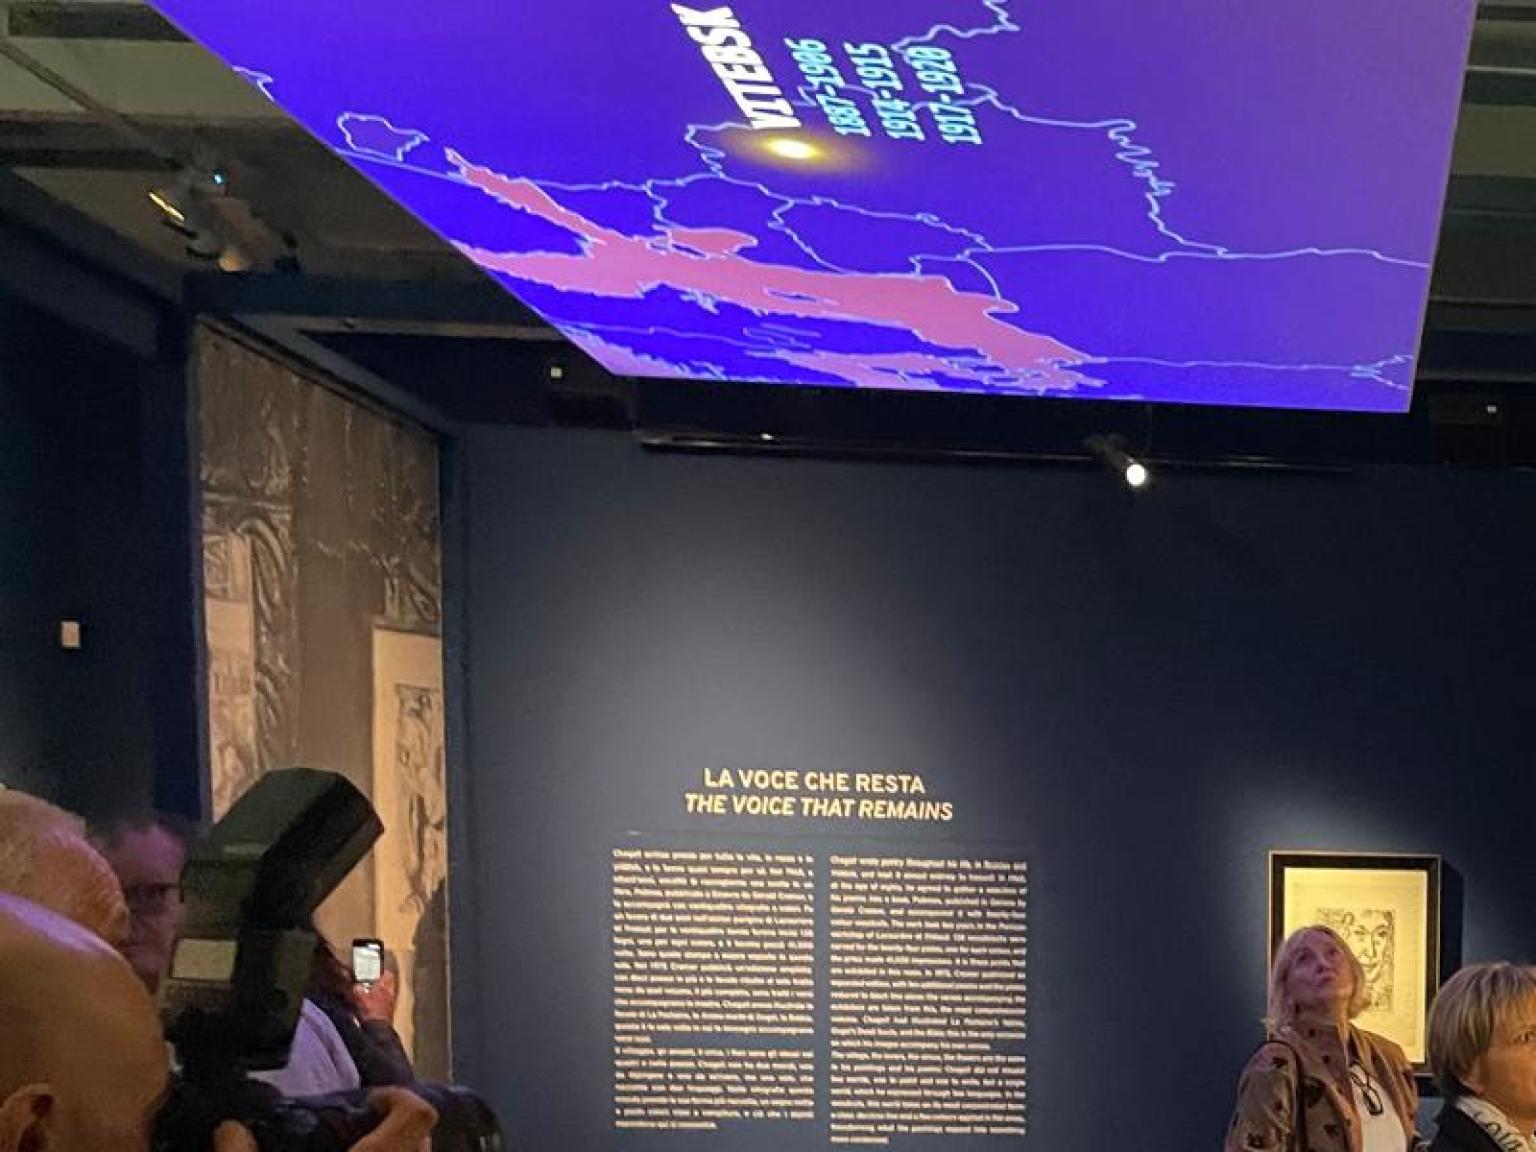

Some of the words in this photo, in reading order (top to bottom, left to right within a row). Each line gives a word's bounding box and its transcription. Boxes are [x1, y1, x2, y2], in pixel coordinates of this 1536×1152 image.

[670, 2, 801, 129] VITEBSK
[843, 41, 925, 140] 1914-1915
[905, 45, 983, 144] 1917-1920
[685, 792, 727, 814] THE
[732, 795, 796, 816] VOICE
[800, 797, 855, 818] THAT
[858, 799, 953, 822] REMAINS
[704, 768, 734, 788] LA
[738, 769, 799, 790] VOCE
[804, 771, 849, 792] CHE
[855, 773, 926, 795] RESTA
